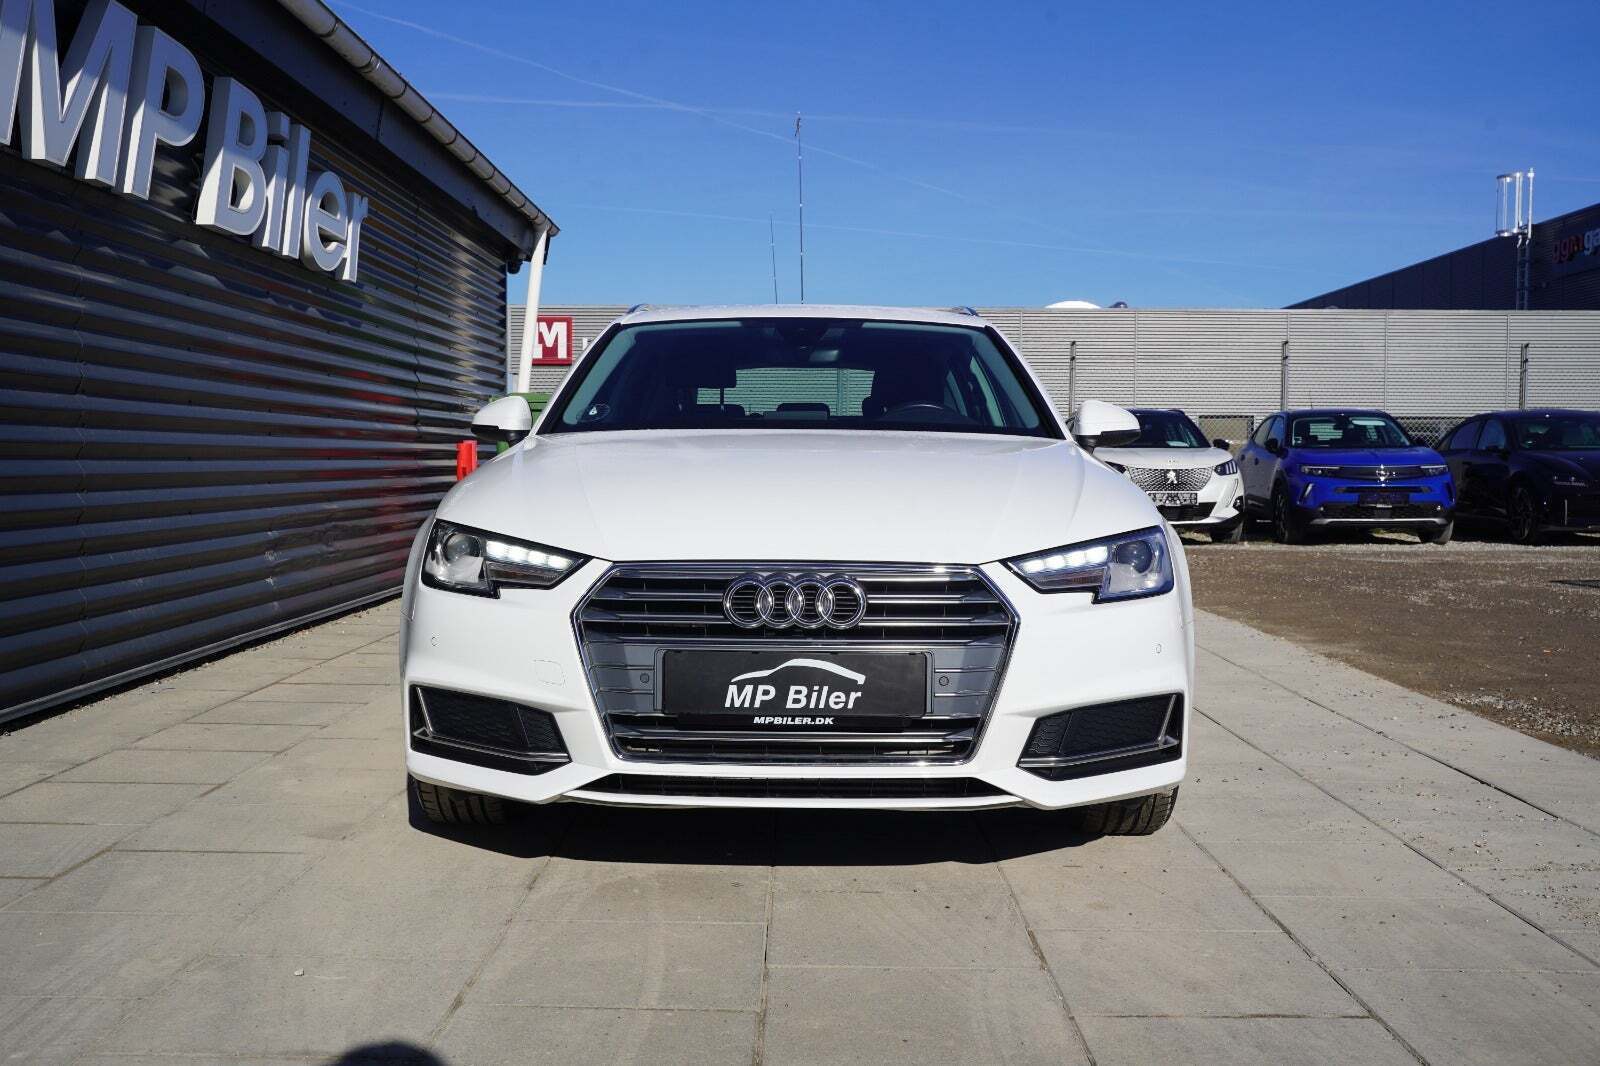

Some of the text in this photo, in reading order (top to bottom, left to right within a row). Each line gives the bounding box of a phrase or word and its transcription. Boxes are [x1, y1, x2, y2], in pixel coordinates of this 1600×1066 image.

[0, 0, 368, 284] MP Biler
[724, 684, 863, 709] MP Biler
[753, 716, 835, 725] MPBILER.DK
